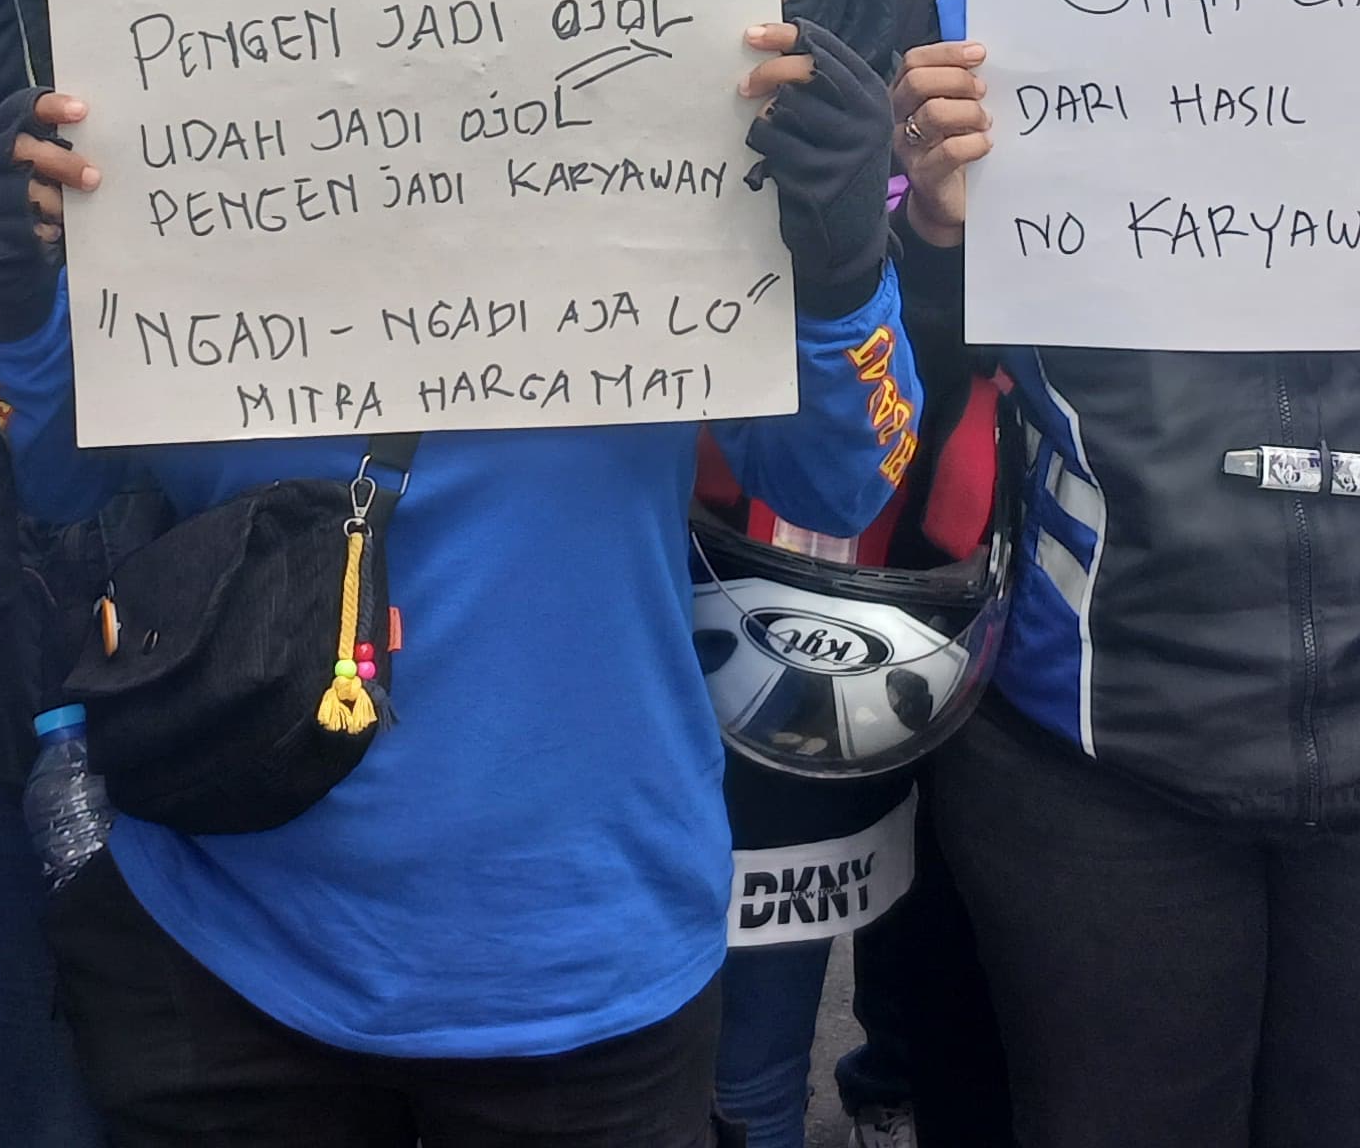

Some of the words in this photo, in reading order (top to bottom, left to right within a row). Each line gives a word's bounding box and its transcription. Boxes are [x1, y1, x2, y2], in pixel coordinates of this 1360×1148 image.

[129, 8, 341, 91] PENGEN
[377, 0, 503, 51] JADI
[141, 119, 285, 168] UDAH
[310, 108, 422, 153] JADI
[1016, 82, 1127, 136] DARI
[1170, 83, 1307, 128] HASIL
[149, 174, 358, 237] PENGEN
[507, 159, 727, 198] KARYAWAN
[1015, 211, 1085, 257] NO
[383, 297, 526, 345] NGADI
[557, 291, 640, 333] AJA
[237, 381, 383, 429] MITRA
[419, 364, 571, 412] HARGA
[739, 852, 877, 929] DKNY
